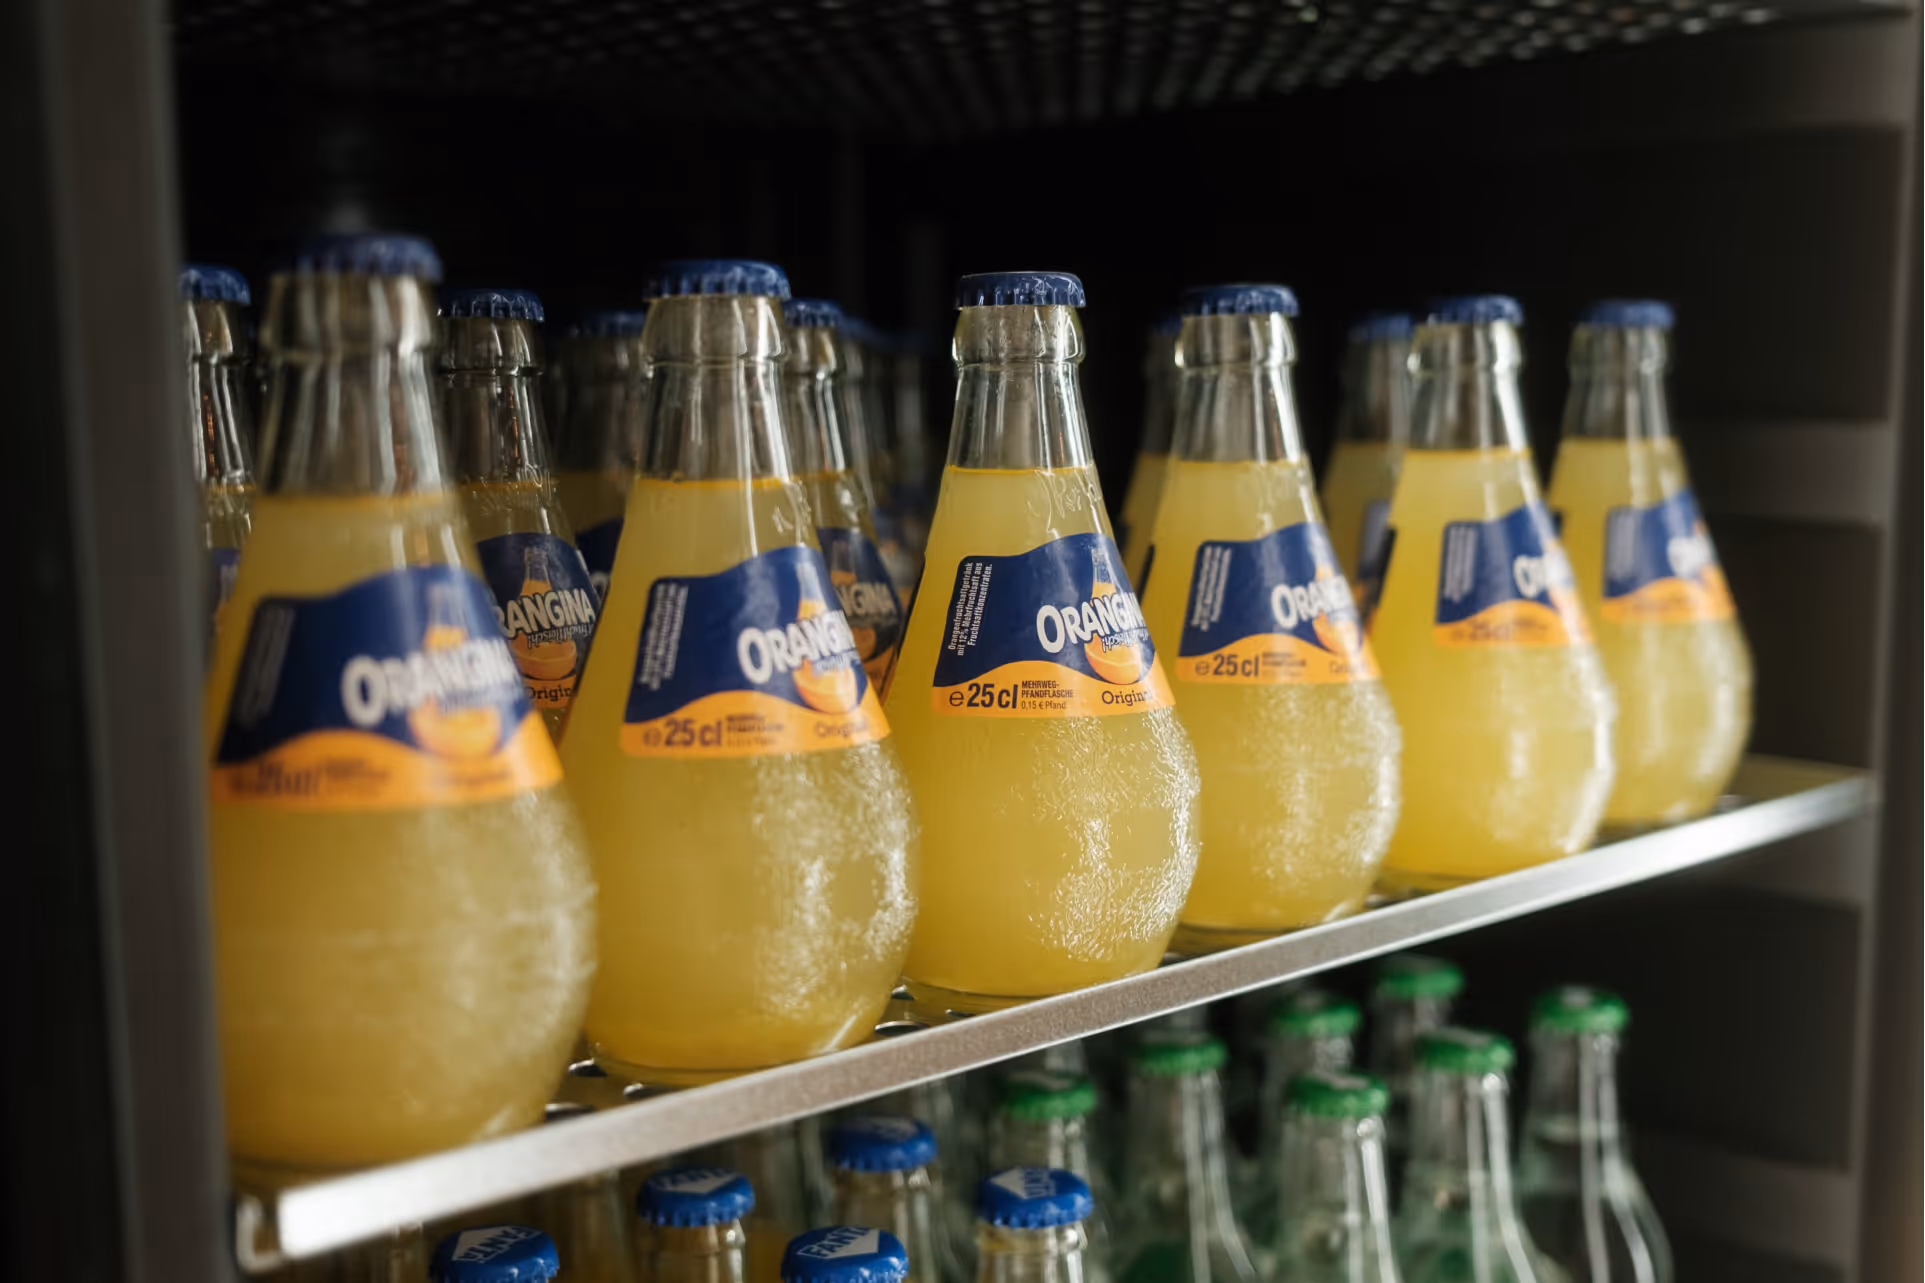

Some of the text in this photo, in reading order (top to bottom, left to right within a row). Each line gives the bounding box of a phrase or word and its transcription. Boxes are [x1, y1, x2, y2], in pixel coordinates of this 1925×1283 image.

[1021, 680, 1060, 690] MEHRWEG-
[1021, 689, 1074, 699] PFANDFLASCHE
[1101, 690, 1147, 707] Origin
[1045, 700, 1067, 710] Pfand
